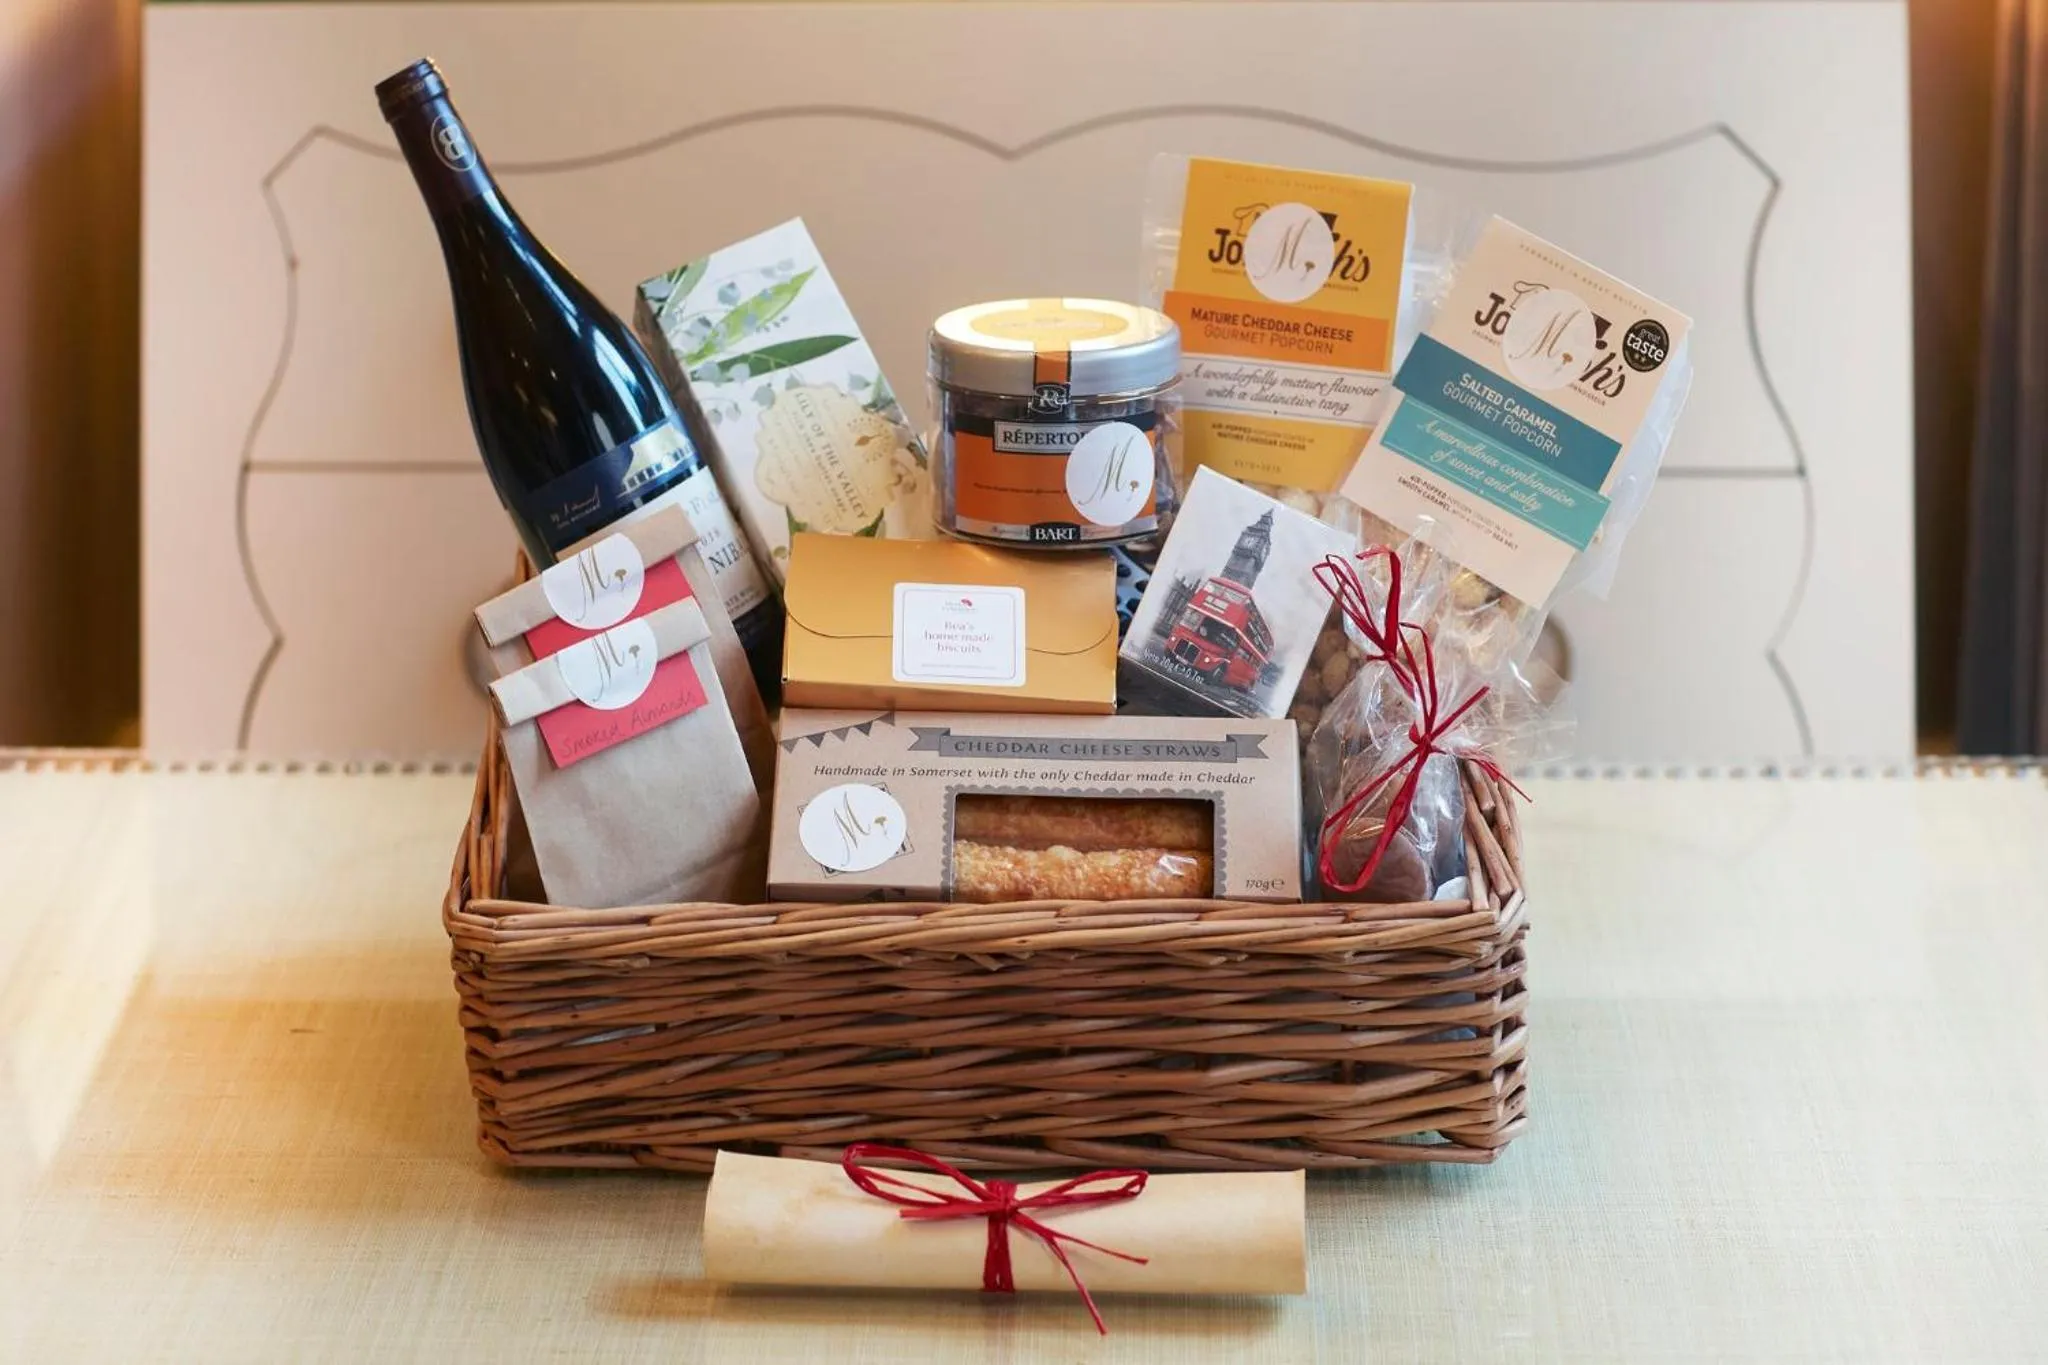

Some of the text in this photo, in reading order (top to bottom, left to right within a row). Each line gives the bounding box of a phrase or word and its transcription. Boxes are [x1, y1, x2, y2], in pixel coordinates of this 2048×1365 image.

[1190, 307, 1354, 342] MATURE CHEDDAR CHEESE
[1204, 324, 1334, 354] GOURMET POPCORN
[1627, 333, 1664, 362] taste
[1185, 362, 1381, 397] A wonderfully mature flavour
[1205, 383, 1350, 416] with a distinctive tang
[1459, 373, 1557, 439] SALTED CARAMEL
[1442, 381, 1562, 457] GOURMET POPCORN
[795, 392, 867, 519] LILY OF THE VALLEY
[1434, 429, 1500, 469] marvellous
[1500, 463, 1577, 508] combination
[1430, 448, 1544, 513] of sweet and salty
[1035, 527, 1076, 541] BART
[944, 621, 976, 632] Bea's
[937, 642, 982, 654] biscuits
[561, 690, 697, 757] Smoked Almonds
[954, 739, 1221, 758] CHEDDAR CHEESE STRAWS
[813, 764, 1256, 785] Handmade in Somerset with the only Cheddar made in Cheddar
